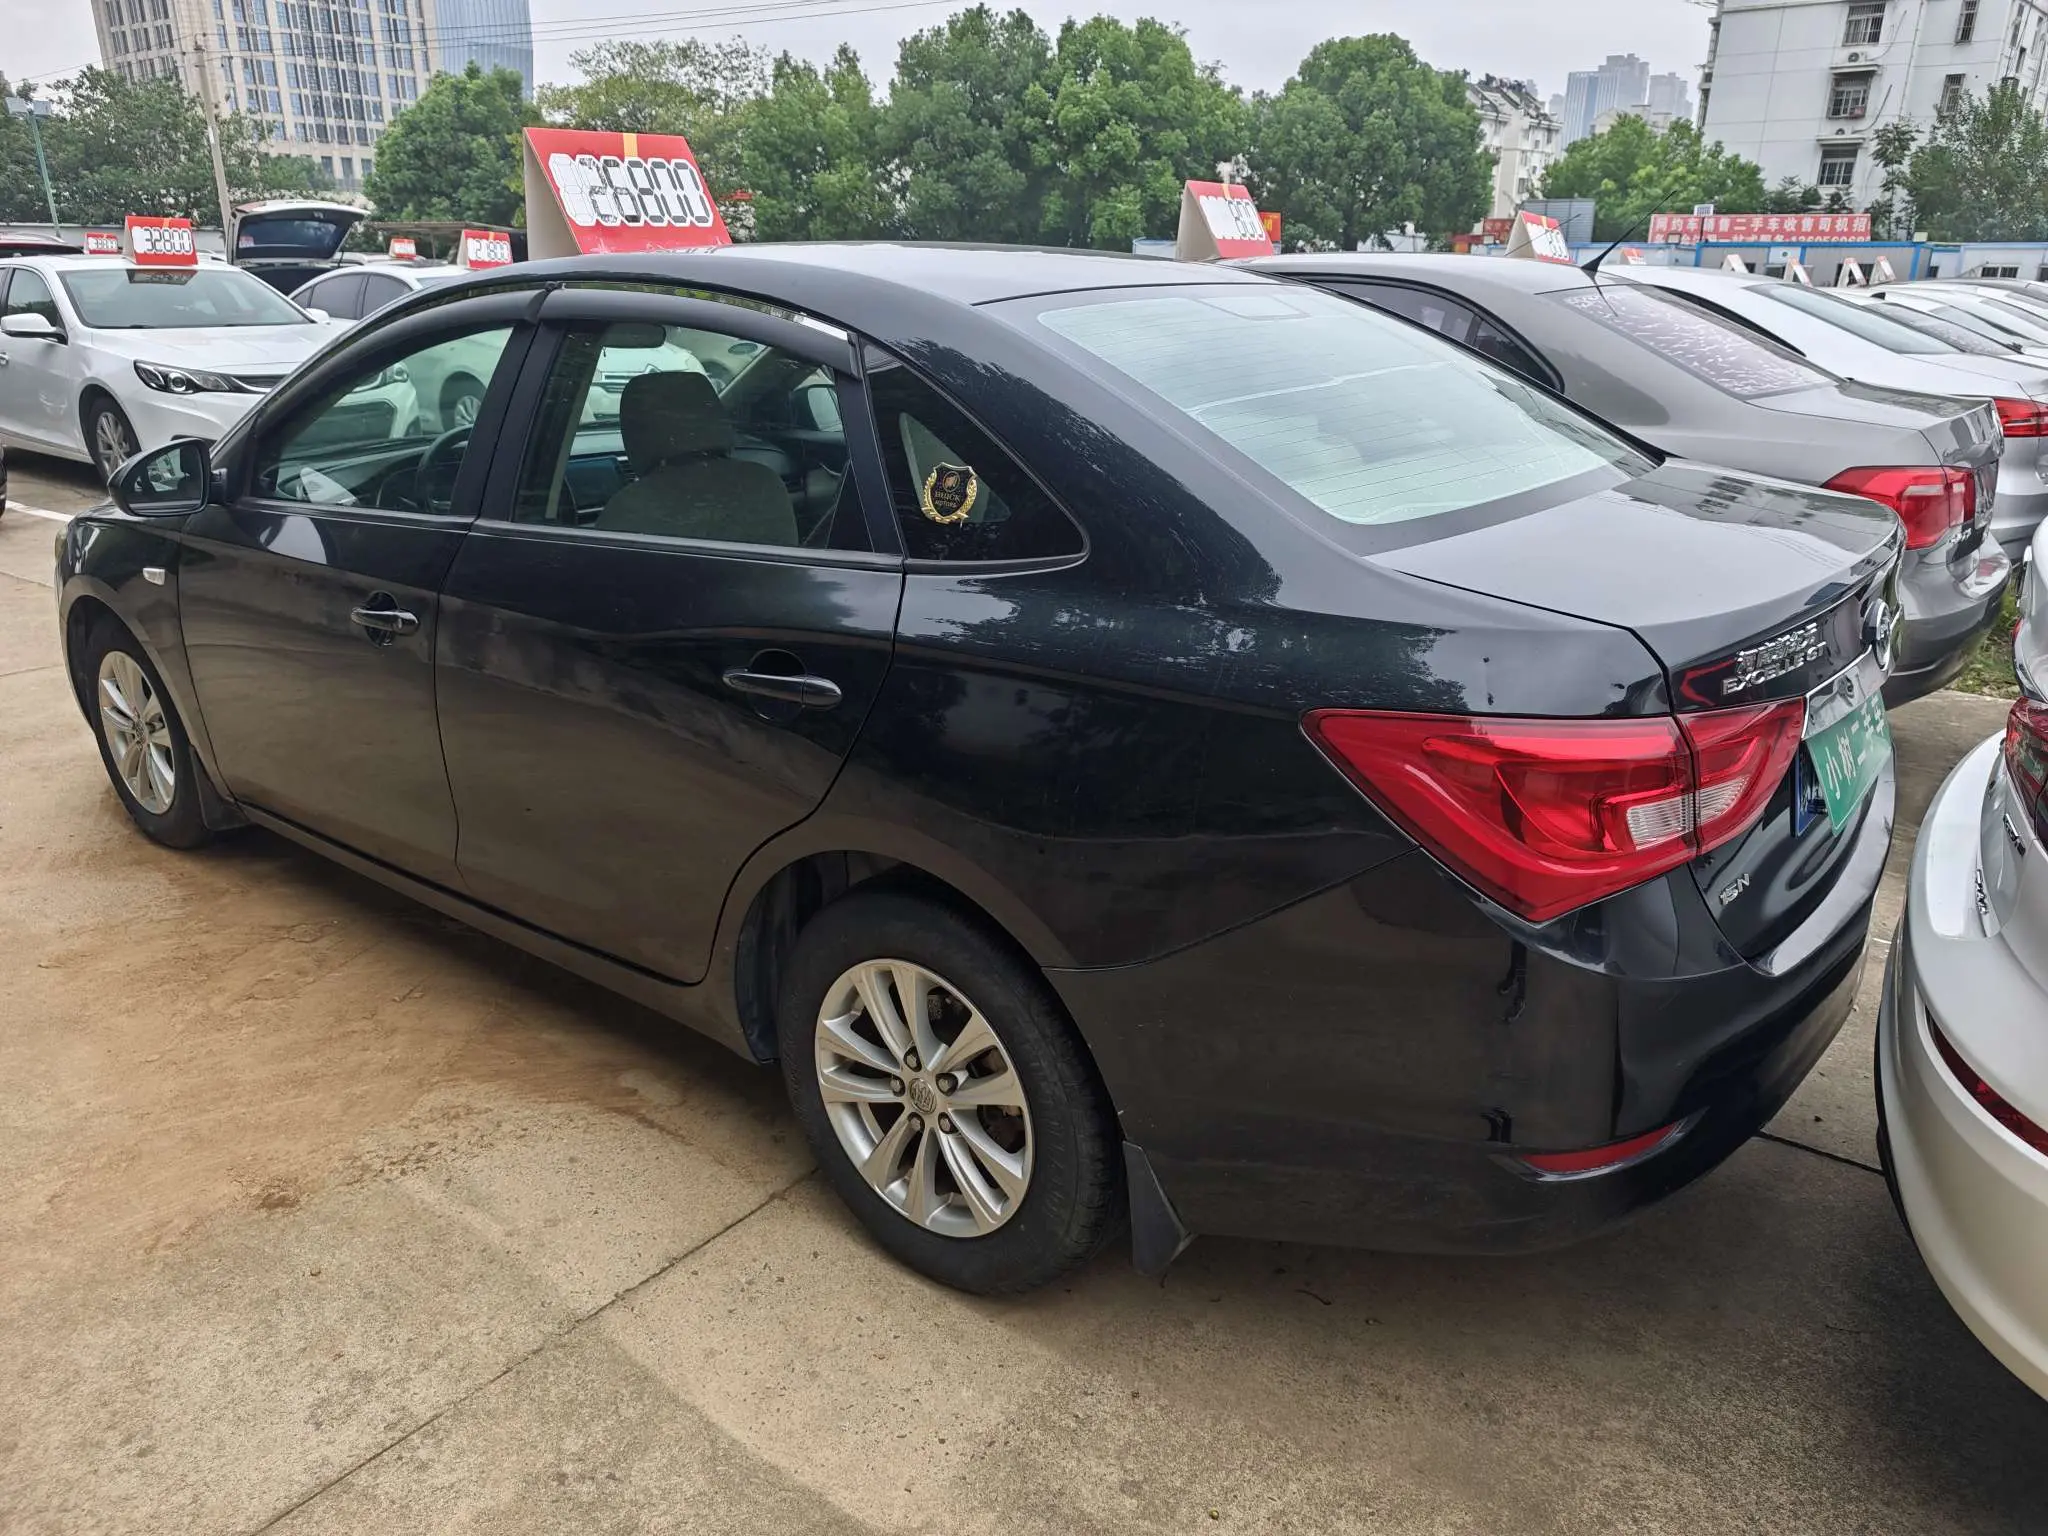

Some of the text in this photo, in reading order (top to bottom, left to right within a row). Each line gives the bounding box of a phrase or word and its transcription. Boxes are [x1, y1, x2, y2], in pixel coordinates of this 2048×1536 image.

[1654, 216, 1870, 233] 网约车销售二手车收售司机招
[143, 228, 192, 253] 32800
[1722, 650, 1806, 695] EXCELLE
[1806, 641, 1827, 661] GT
[1720, 873, 1750, 906] 15N
